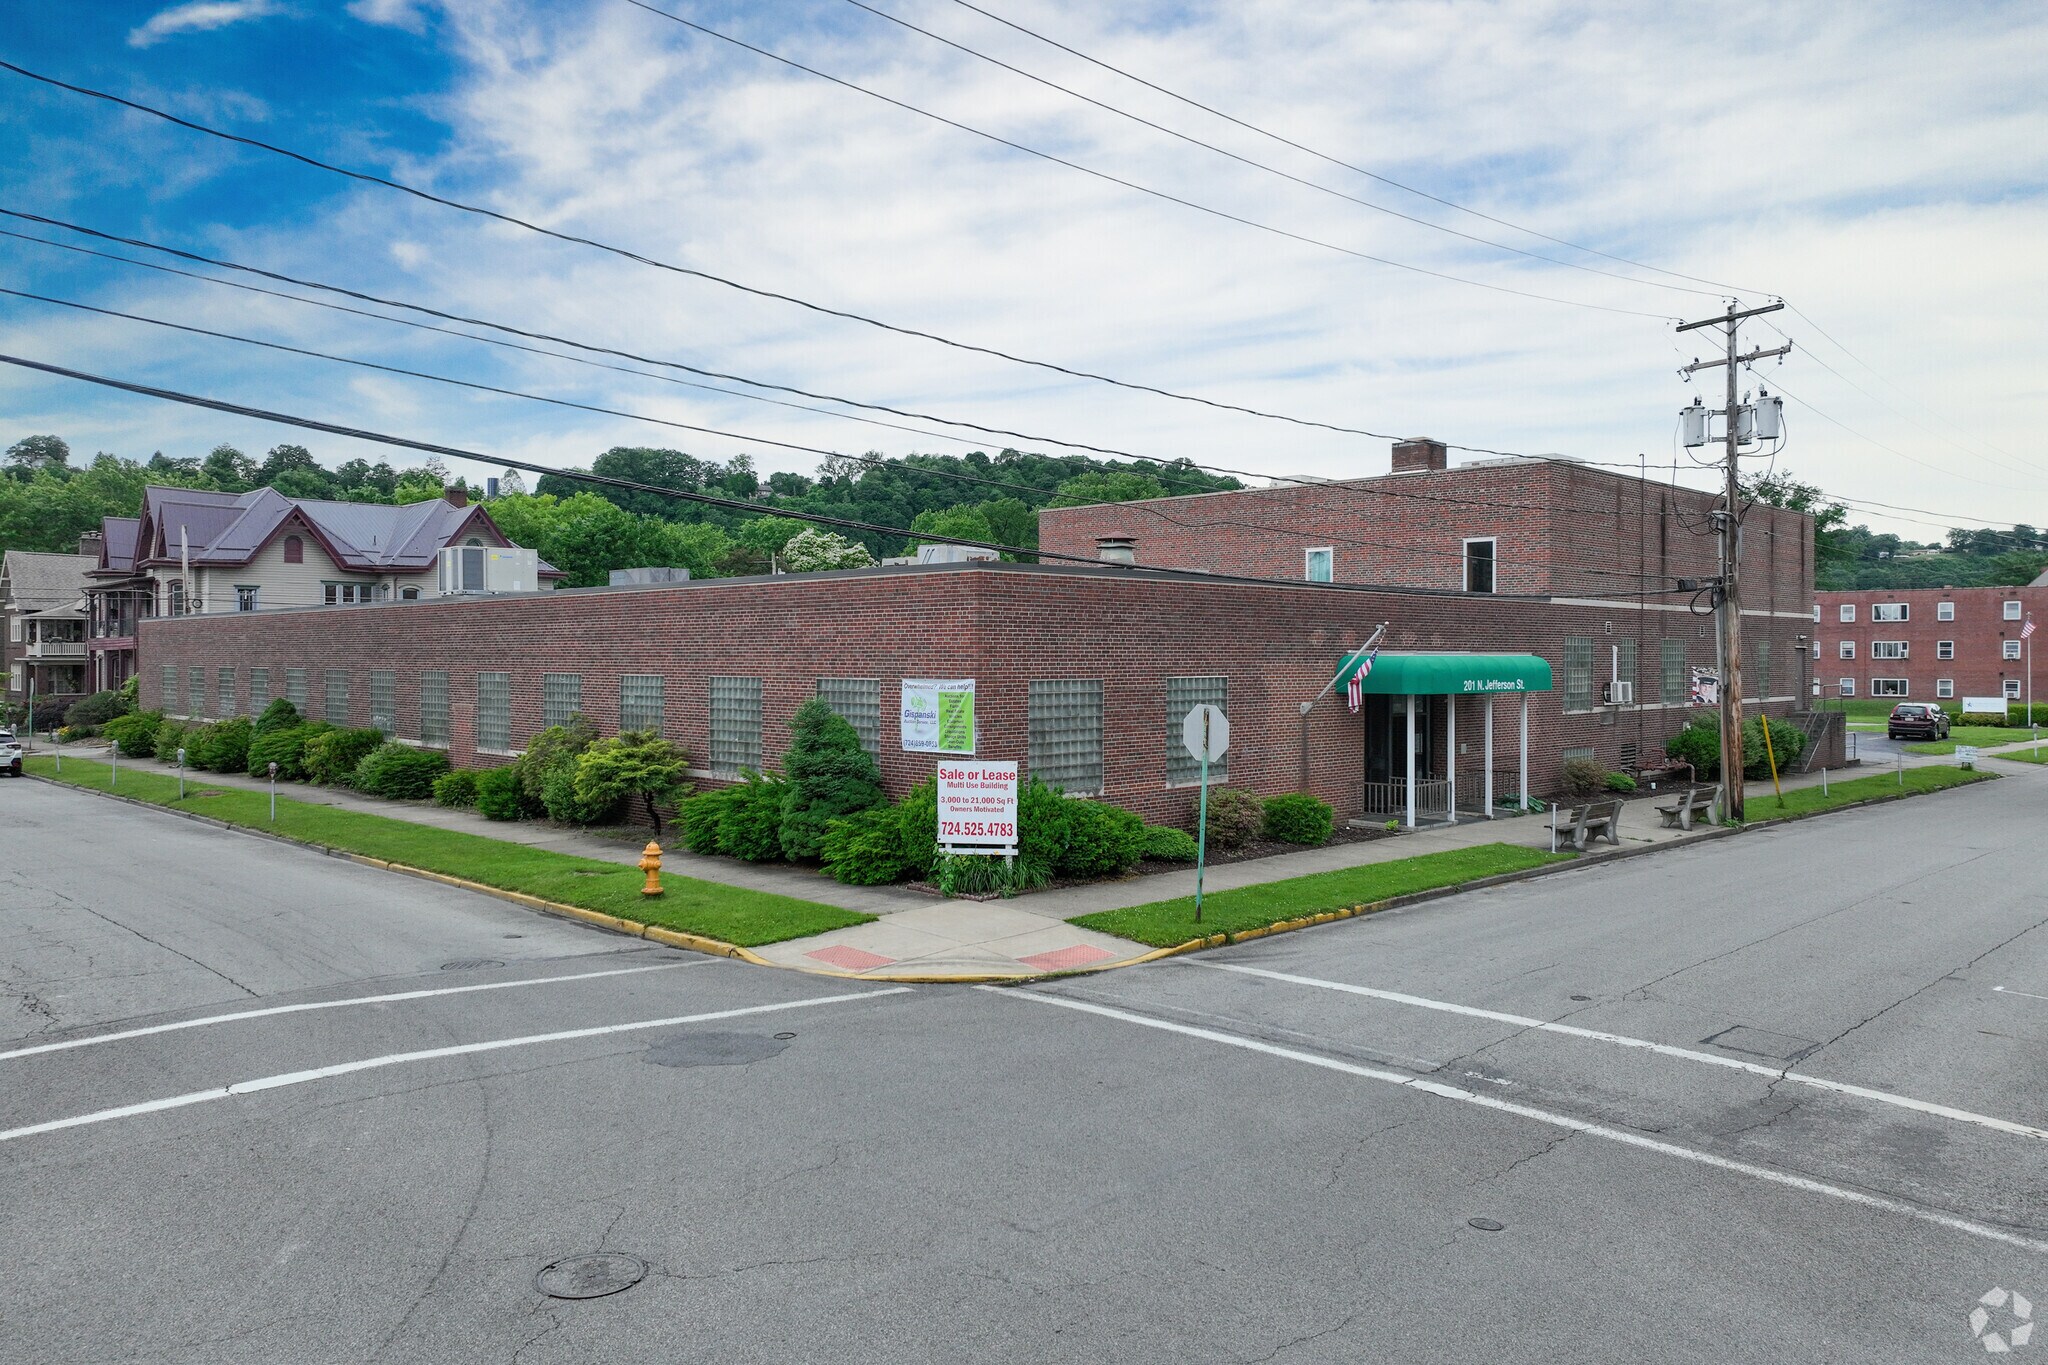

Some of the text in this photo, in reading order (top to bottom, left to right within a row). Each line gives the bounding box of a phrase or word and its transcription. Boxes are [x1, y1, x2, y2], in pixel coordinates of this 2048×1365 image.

[1463, 678, 1525, 691] 201 N. Jefferson St.
[904, 709, 937, 720] Gispanski
[939, 768, 1016, 781] Sale or Lease
[980, 782, 1009, 791] Building
[996, 797, 1006, 805] Sq
[1006, 797, 1014, 805] Ft
[941, 821, 1013, 837] 724.525.4783
